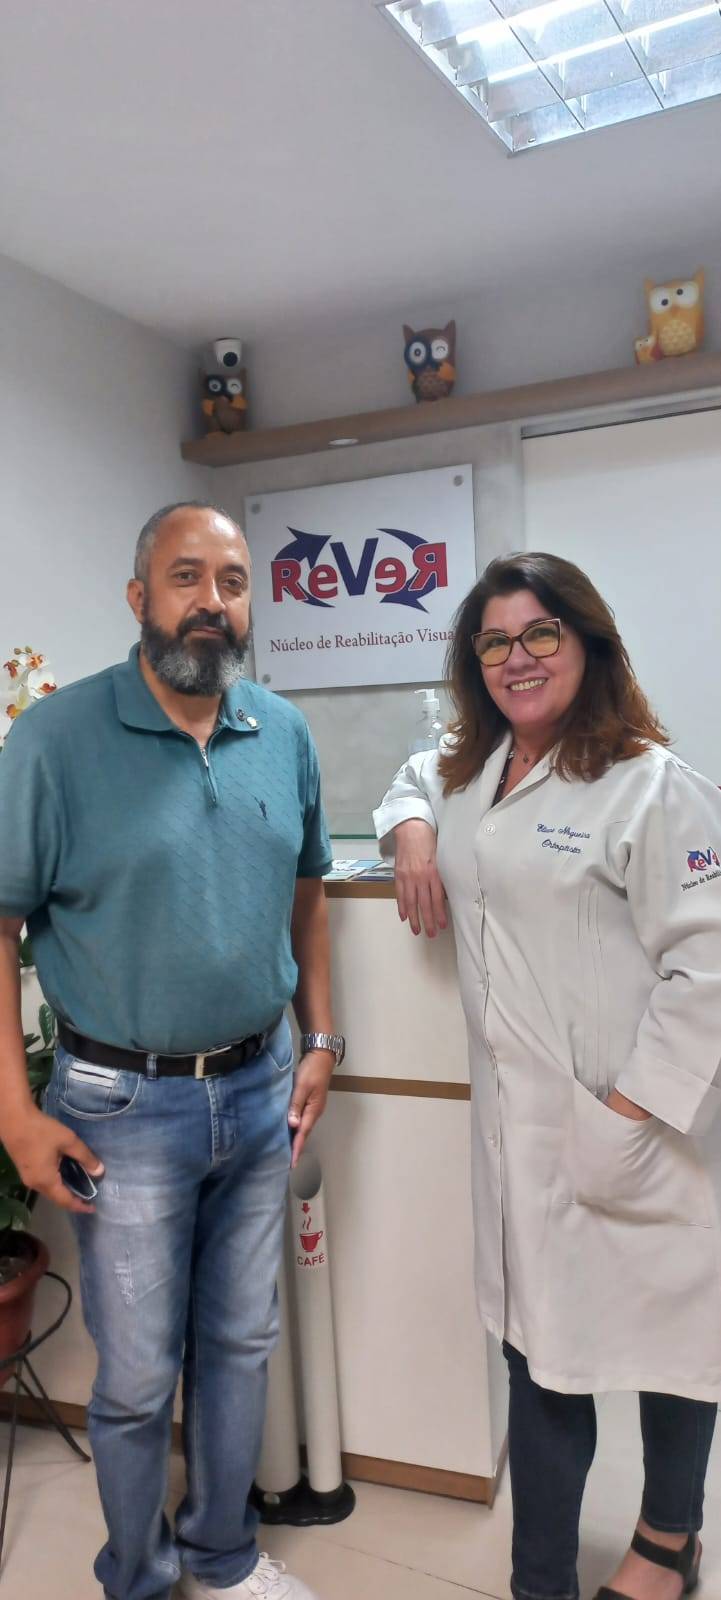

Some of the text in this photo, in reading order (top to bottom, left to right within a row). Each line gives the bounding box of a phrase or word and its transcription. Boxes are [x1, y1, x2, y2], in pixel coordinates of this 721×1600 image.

[270, 628, 456, 653] Núcleo de Reabilitação Visua
[297, 1252, 325, 1266] CAFÉ
